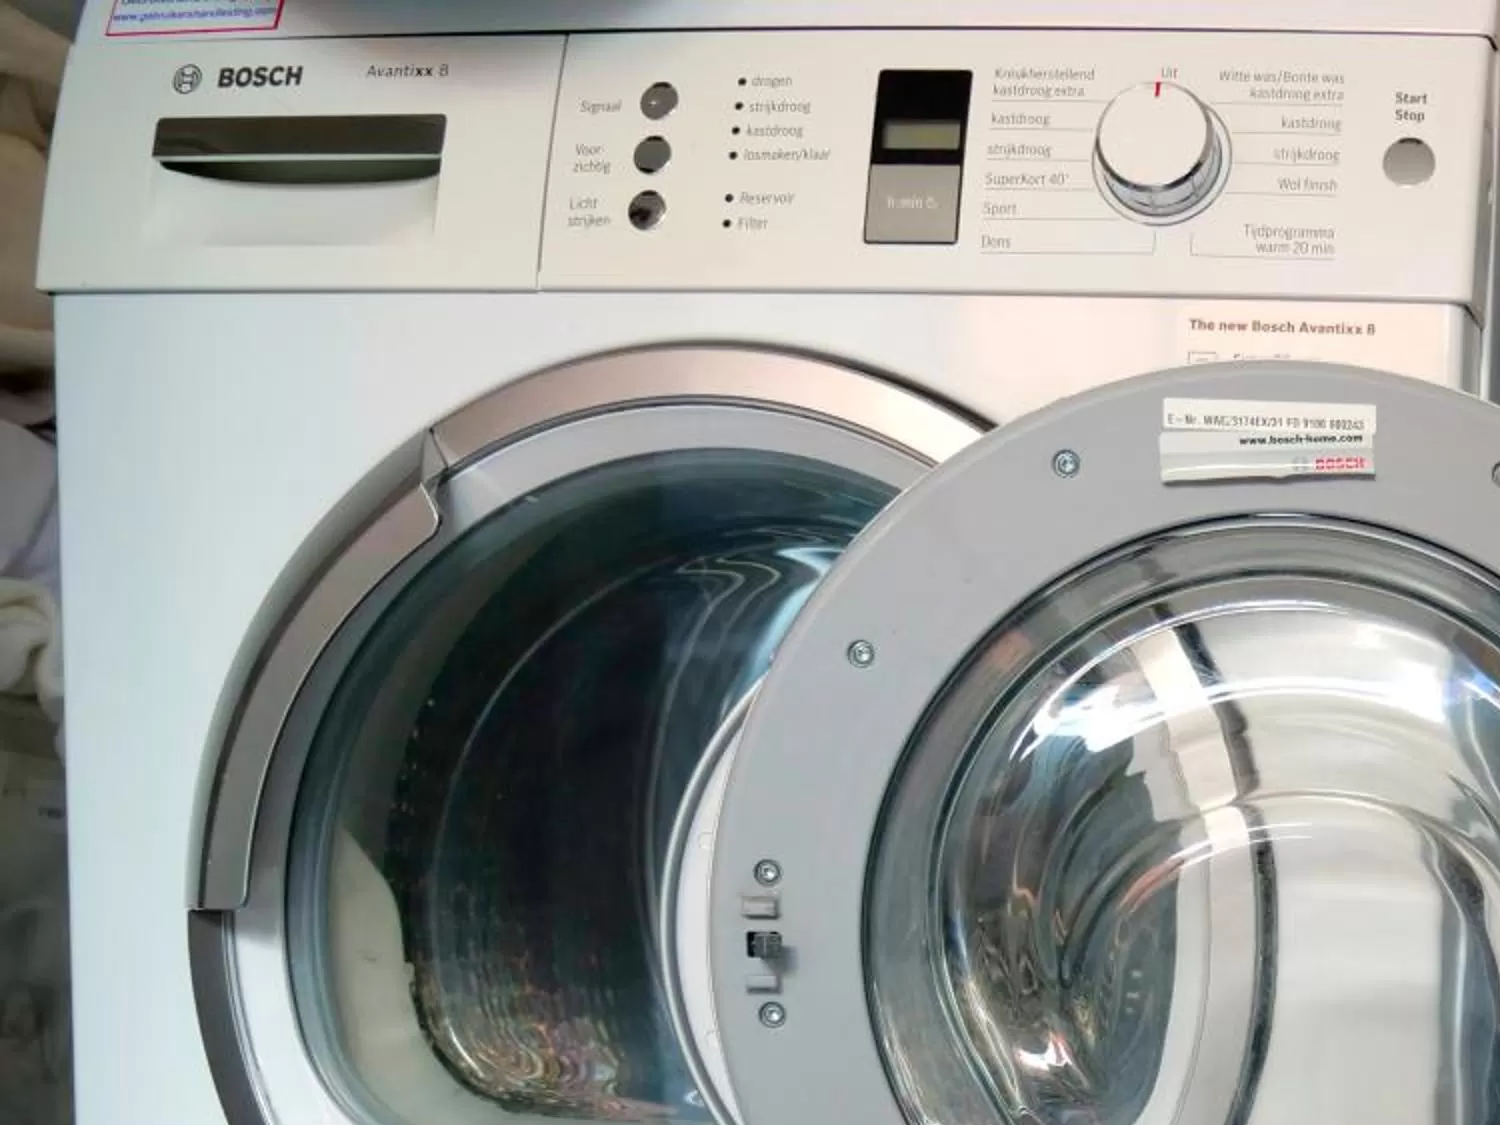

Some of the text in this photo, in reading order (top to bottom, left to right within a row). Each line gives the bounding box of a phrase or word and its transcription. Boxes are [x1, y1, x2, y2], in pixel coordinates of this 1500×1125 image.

[218, 65, 303, 88] BOSCH
[366, 63, 449, 79] Avantixx 8
[1219, 70, 1250, 84] Witte
[1320, 74, 1345, 85] was
[1395, 92, 1428, 106] Start
[1395, 109, 1425, 123] Stop
[1277, 178, 1301, 192] Wol
[983, 202, 1017, 218] Sport
[1293, 242, 1309, 255] 20
[1189, 318, 1216, 332] The
[1219, 321, 1248, 333] new
[1251, 320, 1295, 334] Bosch
[1299, 321, 1362, 336] Avantixx
[1239, 433, 1363, 446] www.bosch-home.com
